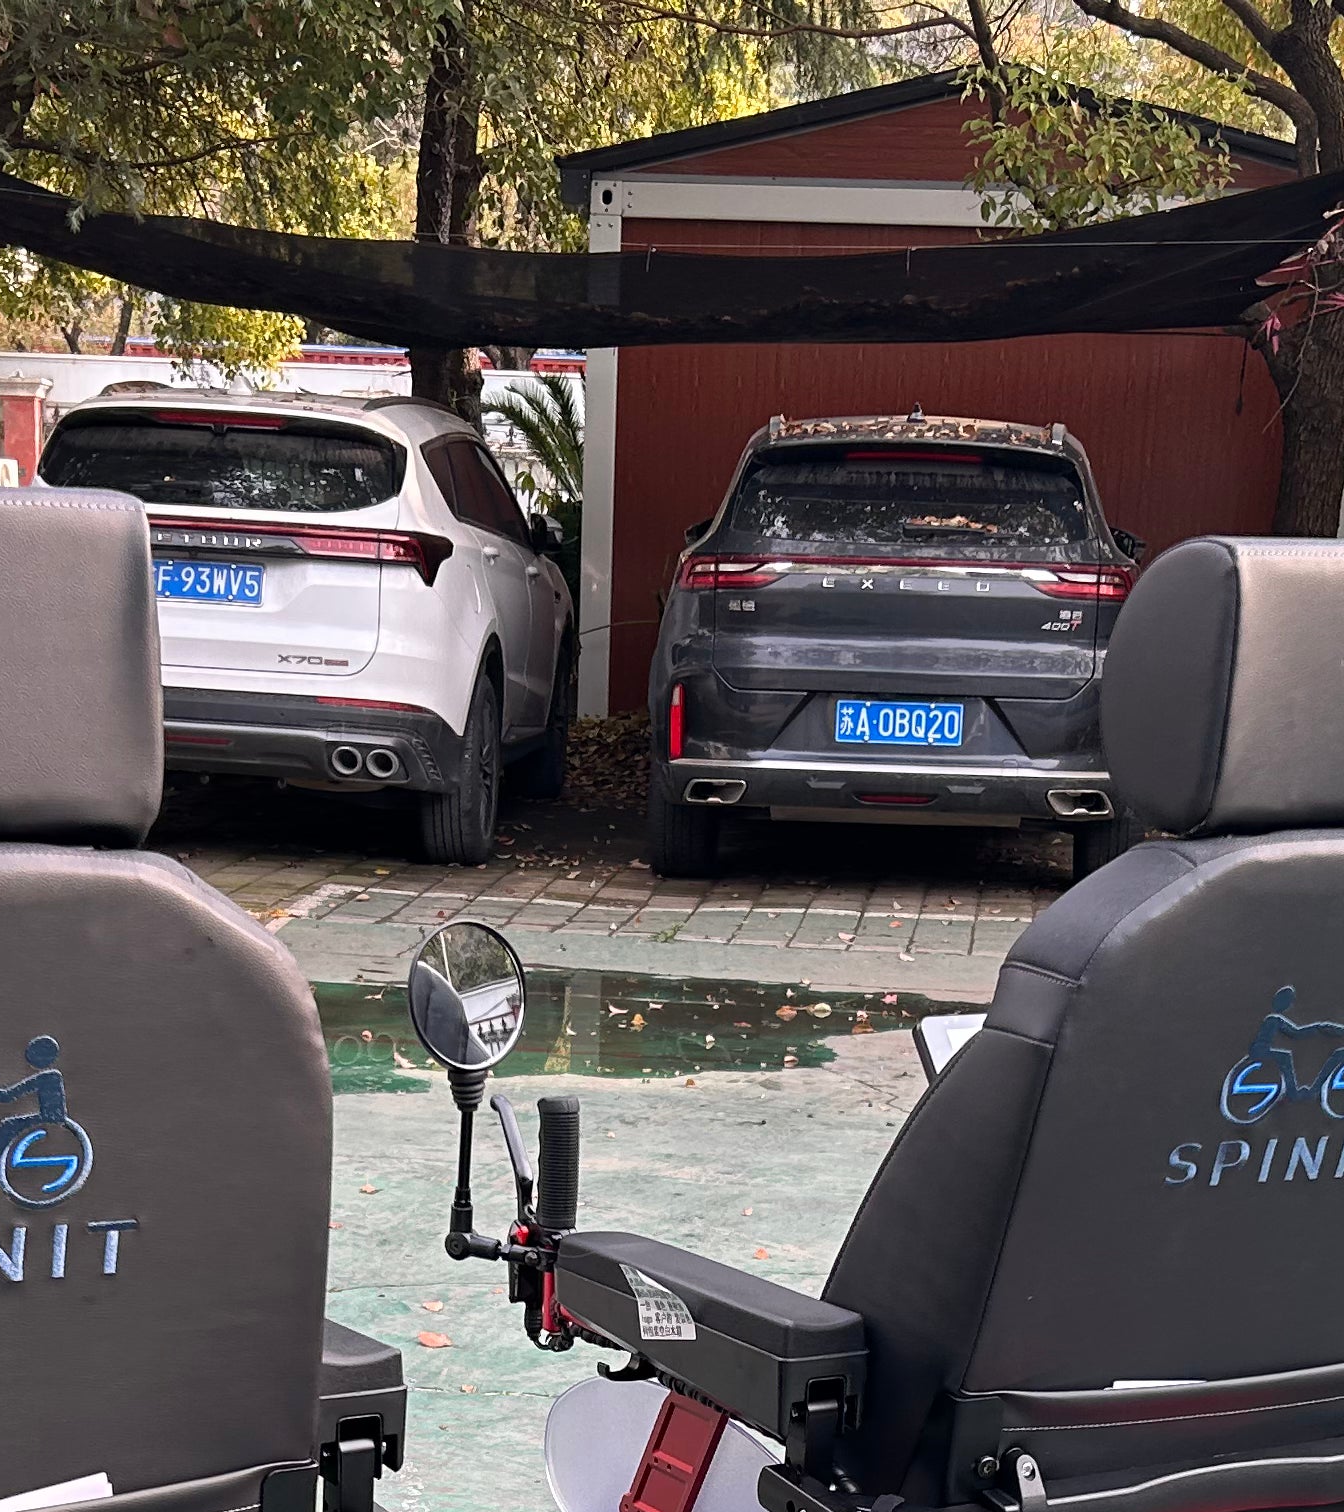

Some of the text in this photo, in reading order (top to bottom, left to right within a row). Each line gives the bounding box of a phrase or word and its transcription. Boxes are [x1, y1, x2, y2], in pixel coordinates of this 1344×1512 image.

[157, 533, 262, 549] ETOUR
[153, 565, 260, 598] F·93WV5
[1041, 620, 1082, 632] 400T
[277, 653, 323, 665] X70
